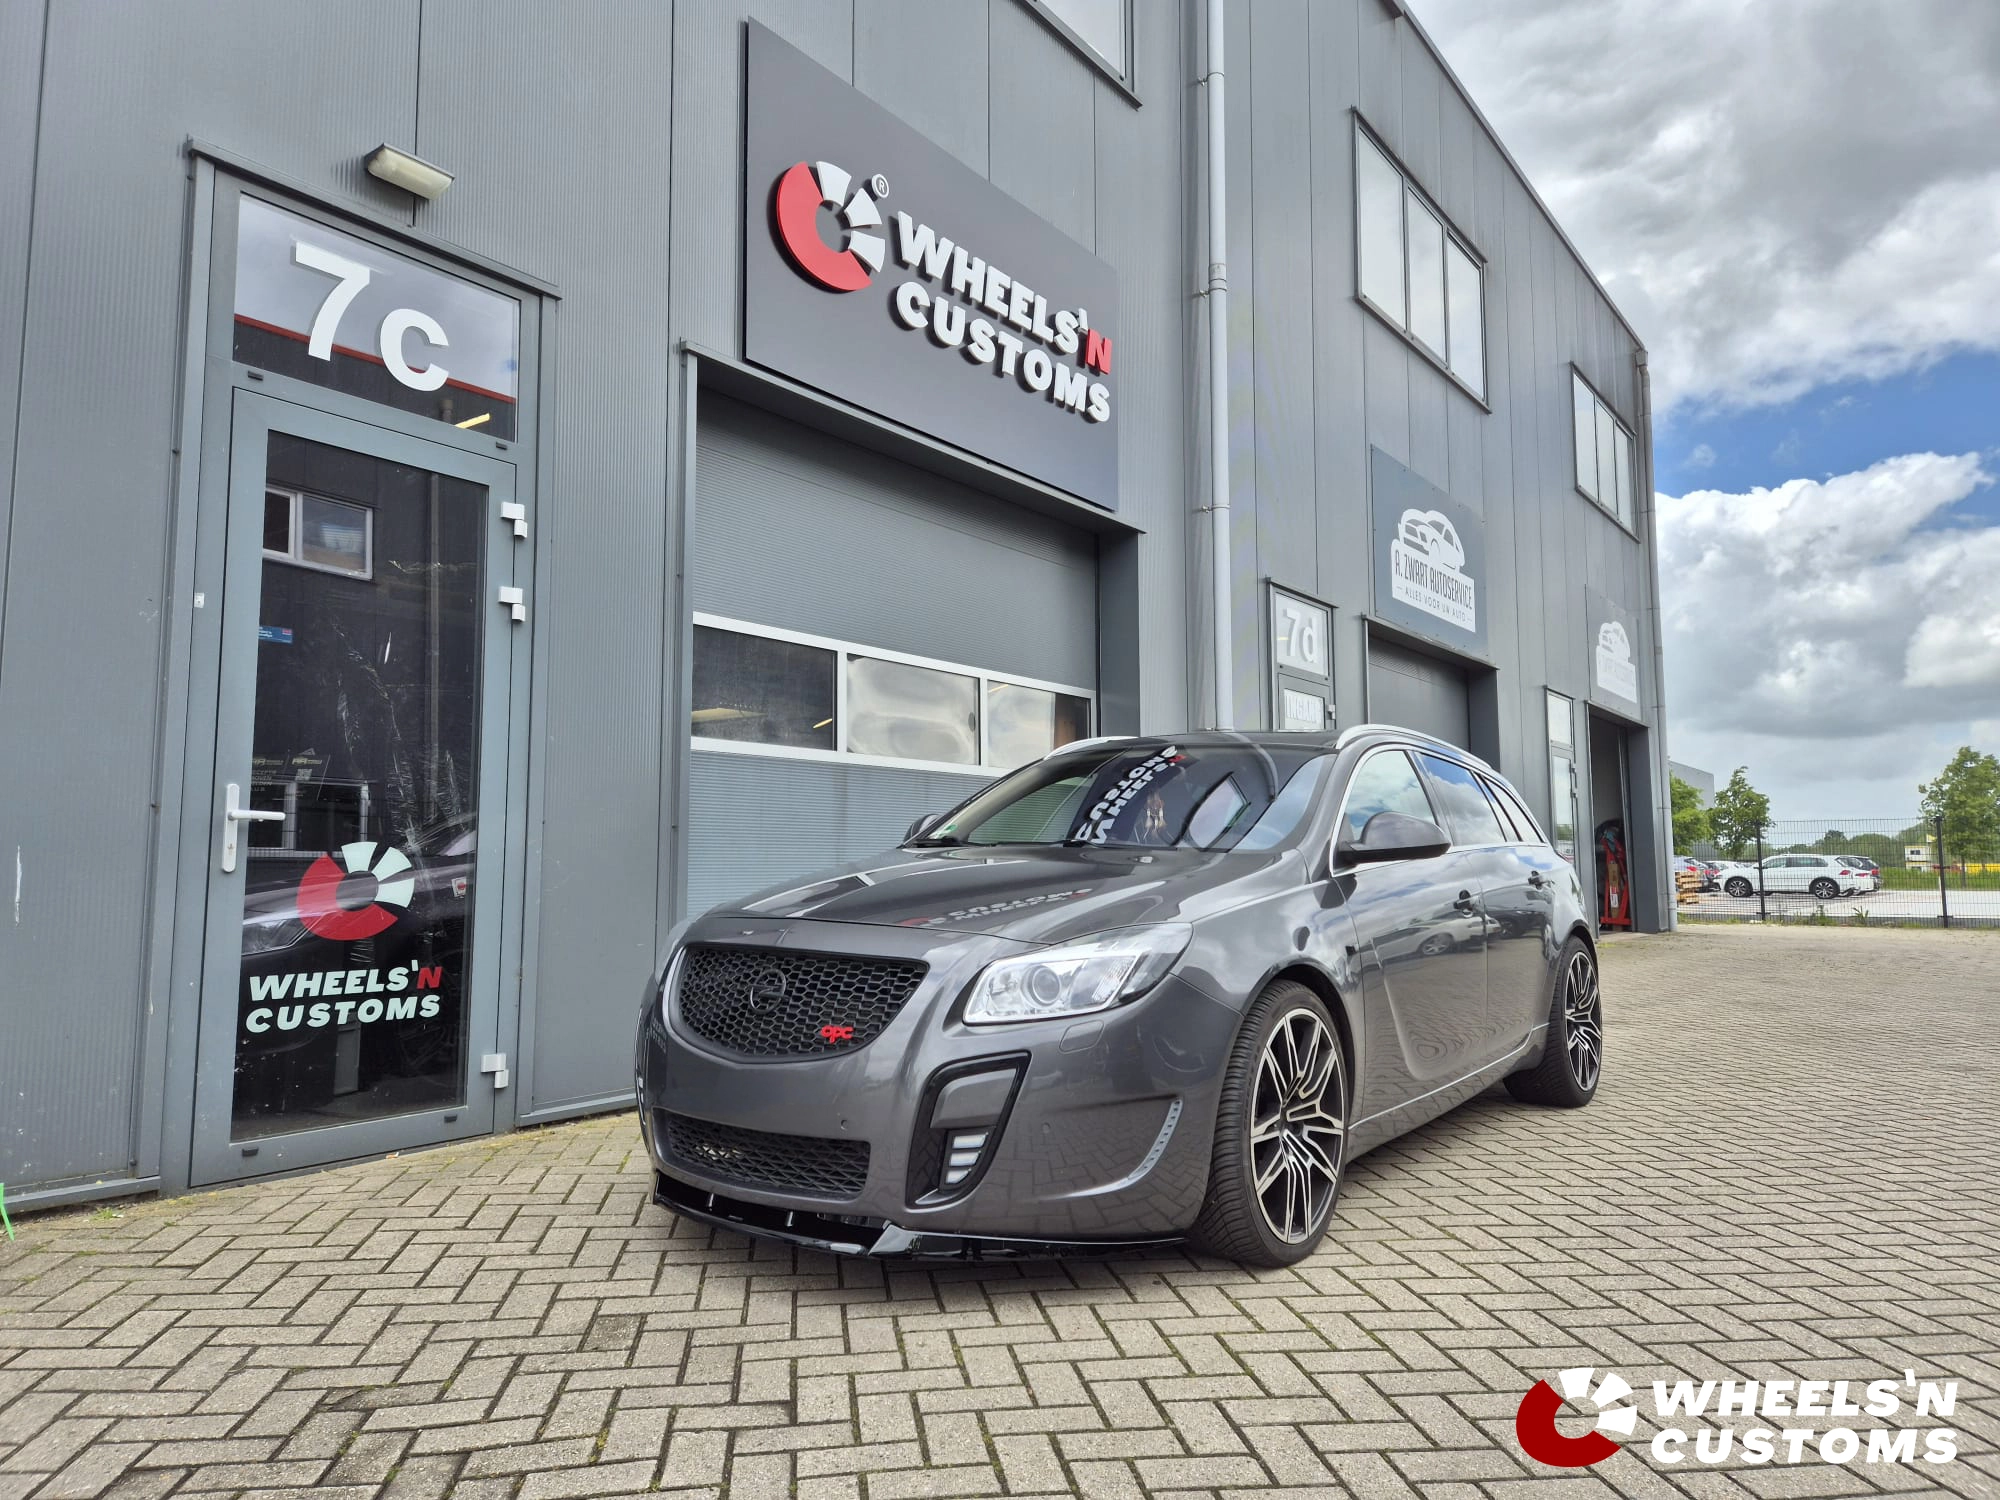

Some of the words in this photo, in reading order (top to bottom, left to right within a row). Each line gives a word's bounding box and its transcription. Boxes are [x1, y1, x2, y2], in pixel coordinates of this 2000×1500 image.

[897, 210, 1112, 374] WHEELS'N
[896, 281, 1111, 422] CUSTOMS
[1430, 567, 1473, 610] AUTOSERVICE
[248, 959, 442, 1000] WHEELS'N
[245, 994, 440, 1033] CUSTOMS
